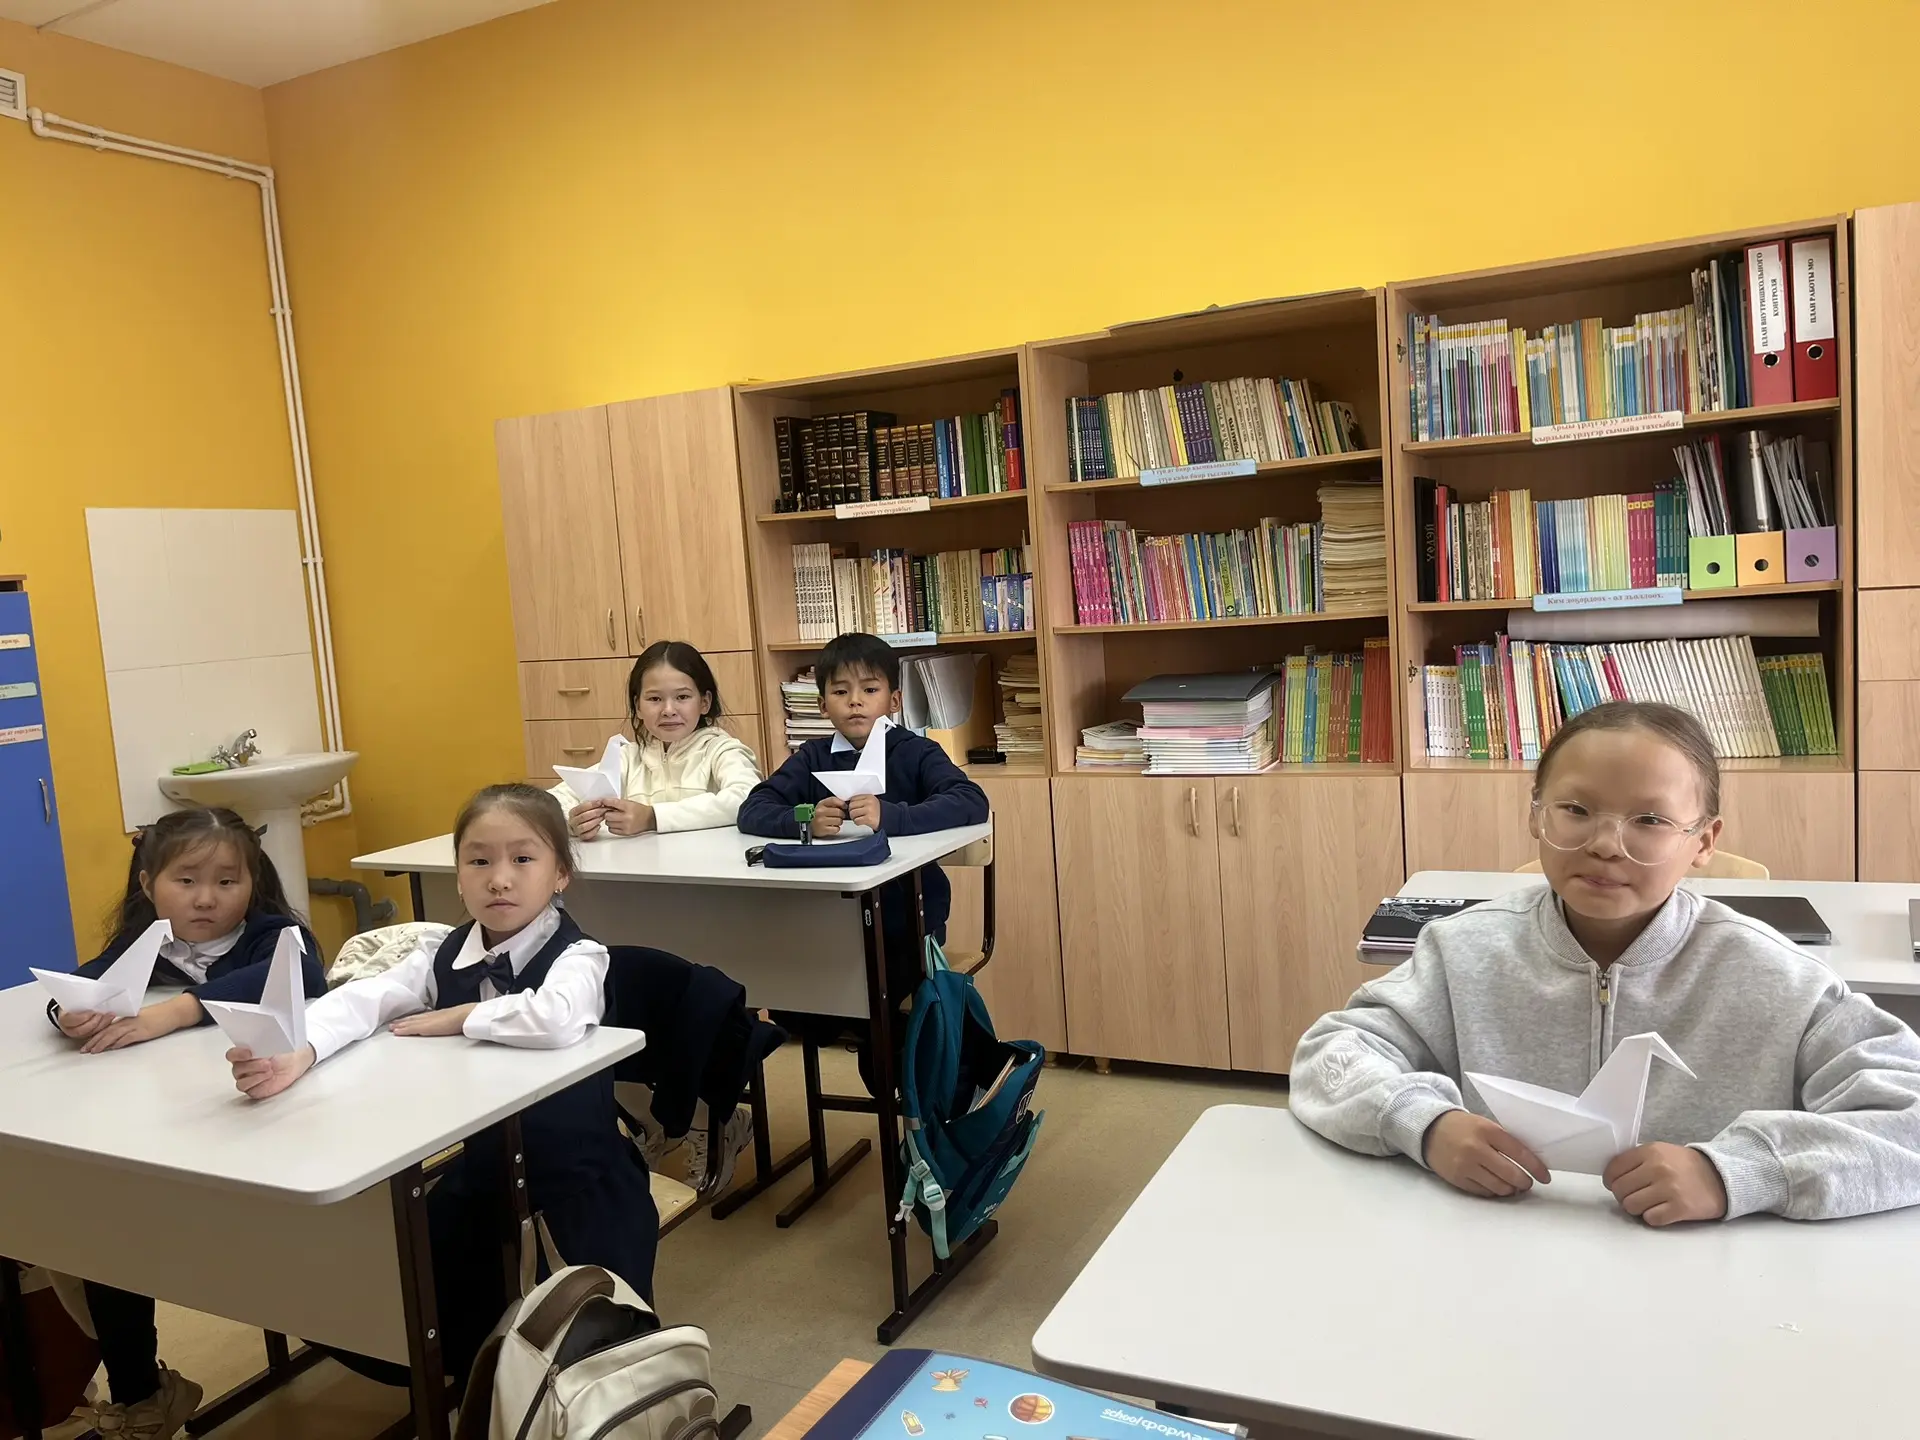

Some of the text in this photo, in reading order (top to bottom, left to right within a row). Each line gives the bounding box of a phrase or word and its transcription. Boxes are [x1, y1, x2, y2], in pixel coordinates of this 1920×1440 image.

[1807, 258, 1814, 271] МО
[1756, 252, 1767, 326] ВНУТРИШКОЛЬНОГО
[1771, 278, 1779, 317] КОНТРОЛЯ
